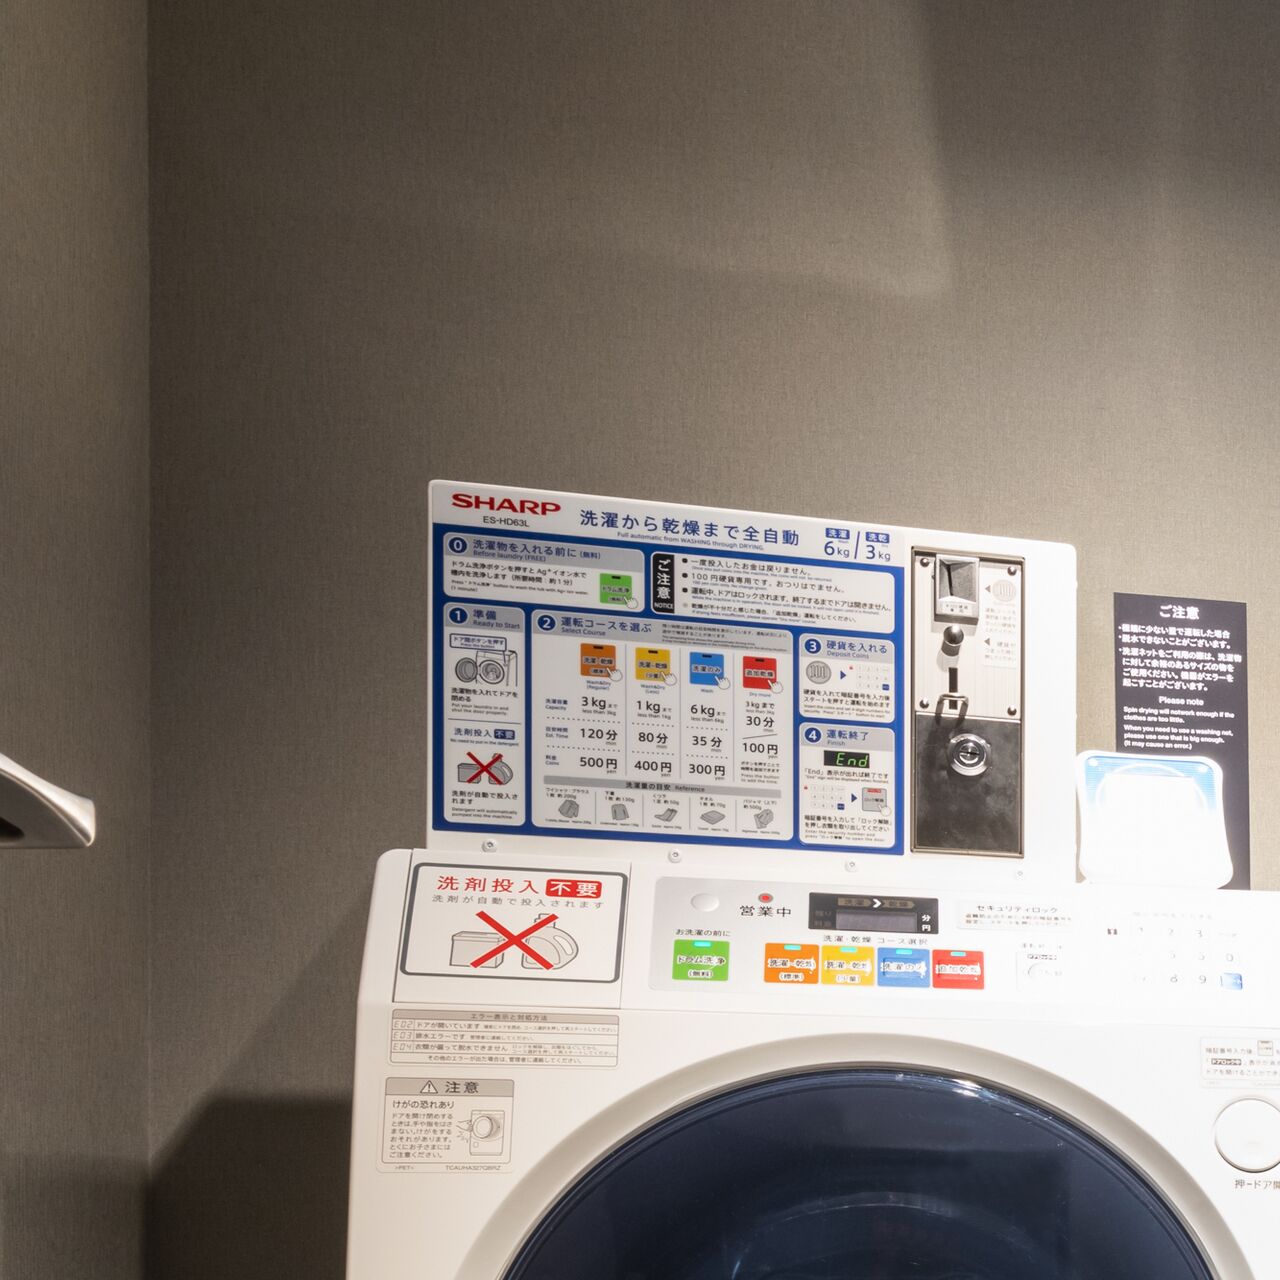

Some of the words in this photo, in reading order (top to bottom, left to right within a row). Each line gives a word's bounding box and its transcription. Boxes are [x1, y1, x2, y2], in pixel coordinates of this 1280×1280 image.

[452, 492, 561, 516] SHARP
[483, 515, 530, 528] ES-HD63L
[580, 509, 799, 546] 洗濯から乾燥まで全自動
[827, 528, 849, 539] 洗濯
[681, 537, 711, 547] WASHING
[473, 539, 576, 559] 洗濯物を入れる前に
[656, 558, 671, 599] ご注意
[654, 602, 674, 610] NOTICE
[1159, 603, 1200, 620] ご注意
[473, 608, 497, 621] 準備
[473, 619, 495, 629] Ready
[504, 622, 521, 630] Start
[561, 616, 652, 633] 運転コースを選ぶ
[583, 628, 606, 636] Course
[826, 640, 887, 654] 硬貨を入れる
[1159, 695, 1185, 705] Please
[1186, 697, 1204, 706] note
[1123, 706, 1138, 714] Spin
[1138, 707, 1158, 716] drying
[1196, 710, 1218, 719] enough
[1123, 714, 1146, 722] clothes
[745, 716, 775, 728] 30分
[454, 727, 492, 738] 洗剤投入
[495, 730, 514, 739] 不要
[580, 728, 618, 741] 120分
[827, 729, 869, 741] 運転終了
[1123, 724, 1142, 732] When
[1155, 725, 1170, 733] need
[1195, 728, 1221, 736] washing
[638, 732, 668, 745] 80分
[692, 735, 722, 748] 35分
[1123, 732, 1144, 741] please
[1201, 736, 1225, 744] enough.
[742, 742, 778, 756] 100円
[580, 757, 617, 770] 500円
[836, 752, 868, 767] End
[634, 760, 672, 774] 400円
[688, 763, 726, 777] 300円
[625, 781, 671, 791] 洗濯量の目安
[437, 875, 540, 895] 洗剤投入
[550, 881, 599, 898] 不要
[432, 894, 605, 910] 洗剤が自動で投入されます
[739, 905, 792, 919] 営業中
[921, 914, 932, 922] 分
[675, 928, 731, 938] お洗濯の前に
[921, 924, 932, 932] 円
[444, 1081, 480, 1094] 注意
[392, 1099, 455, 1110] けがの恐れあり
